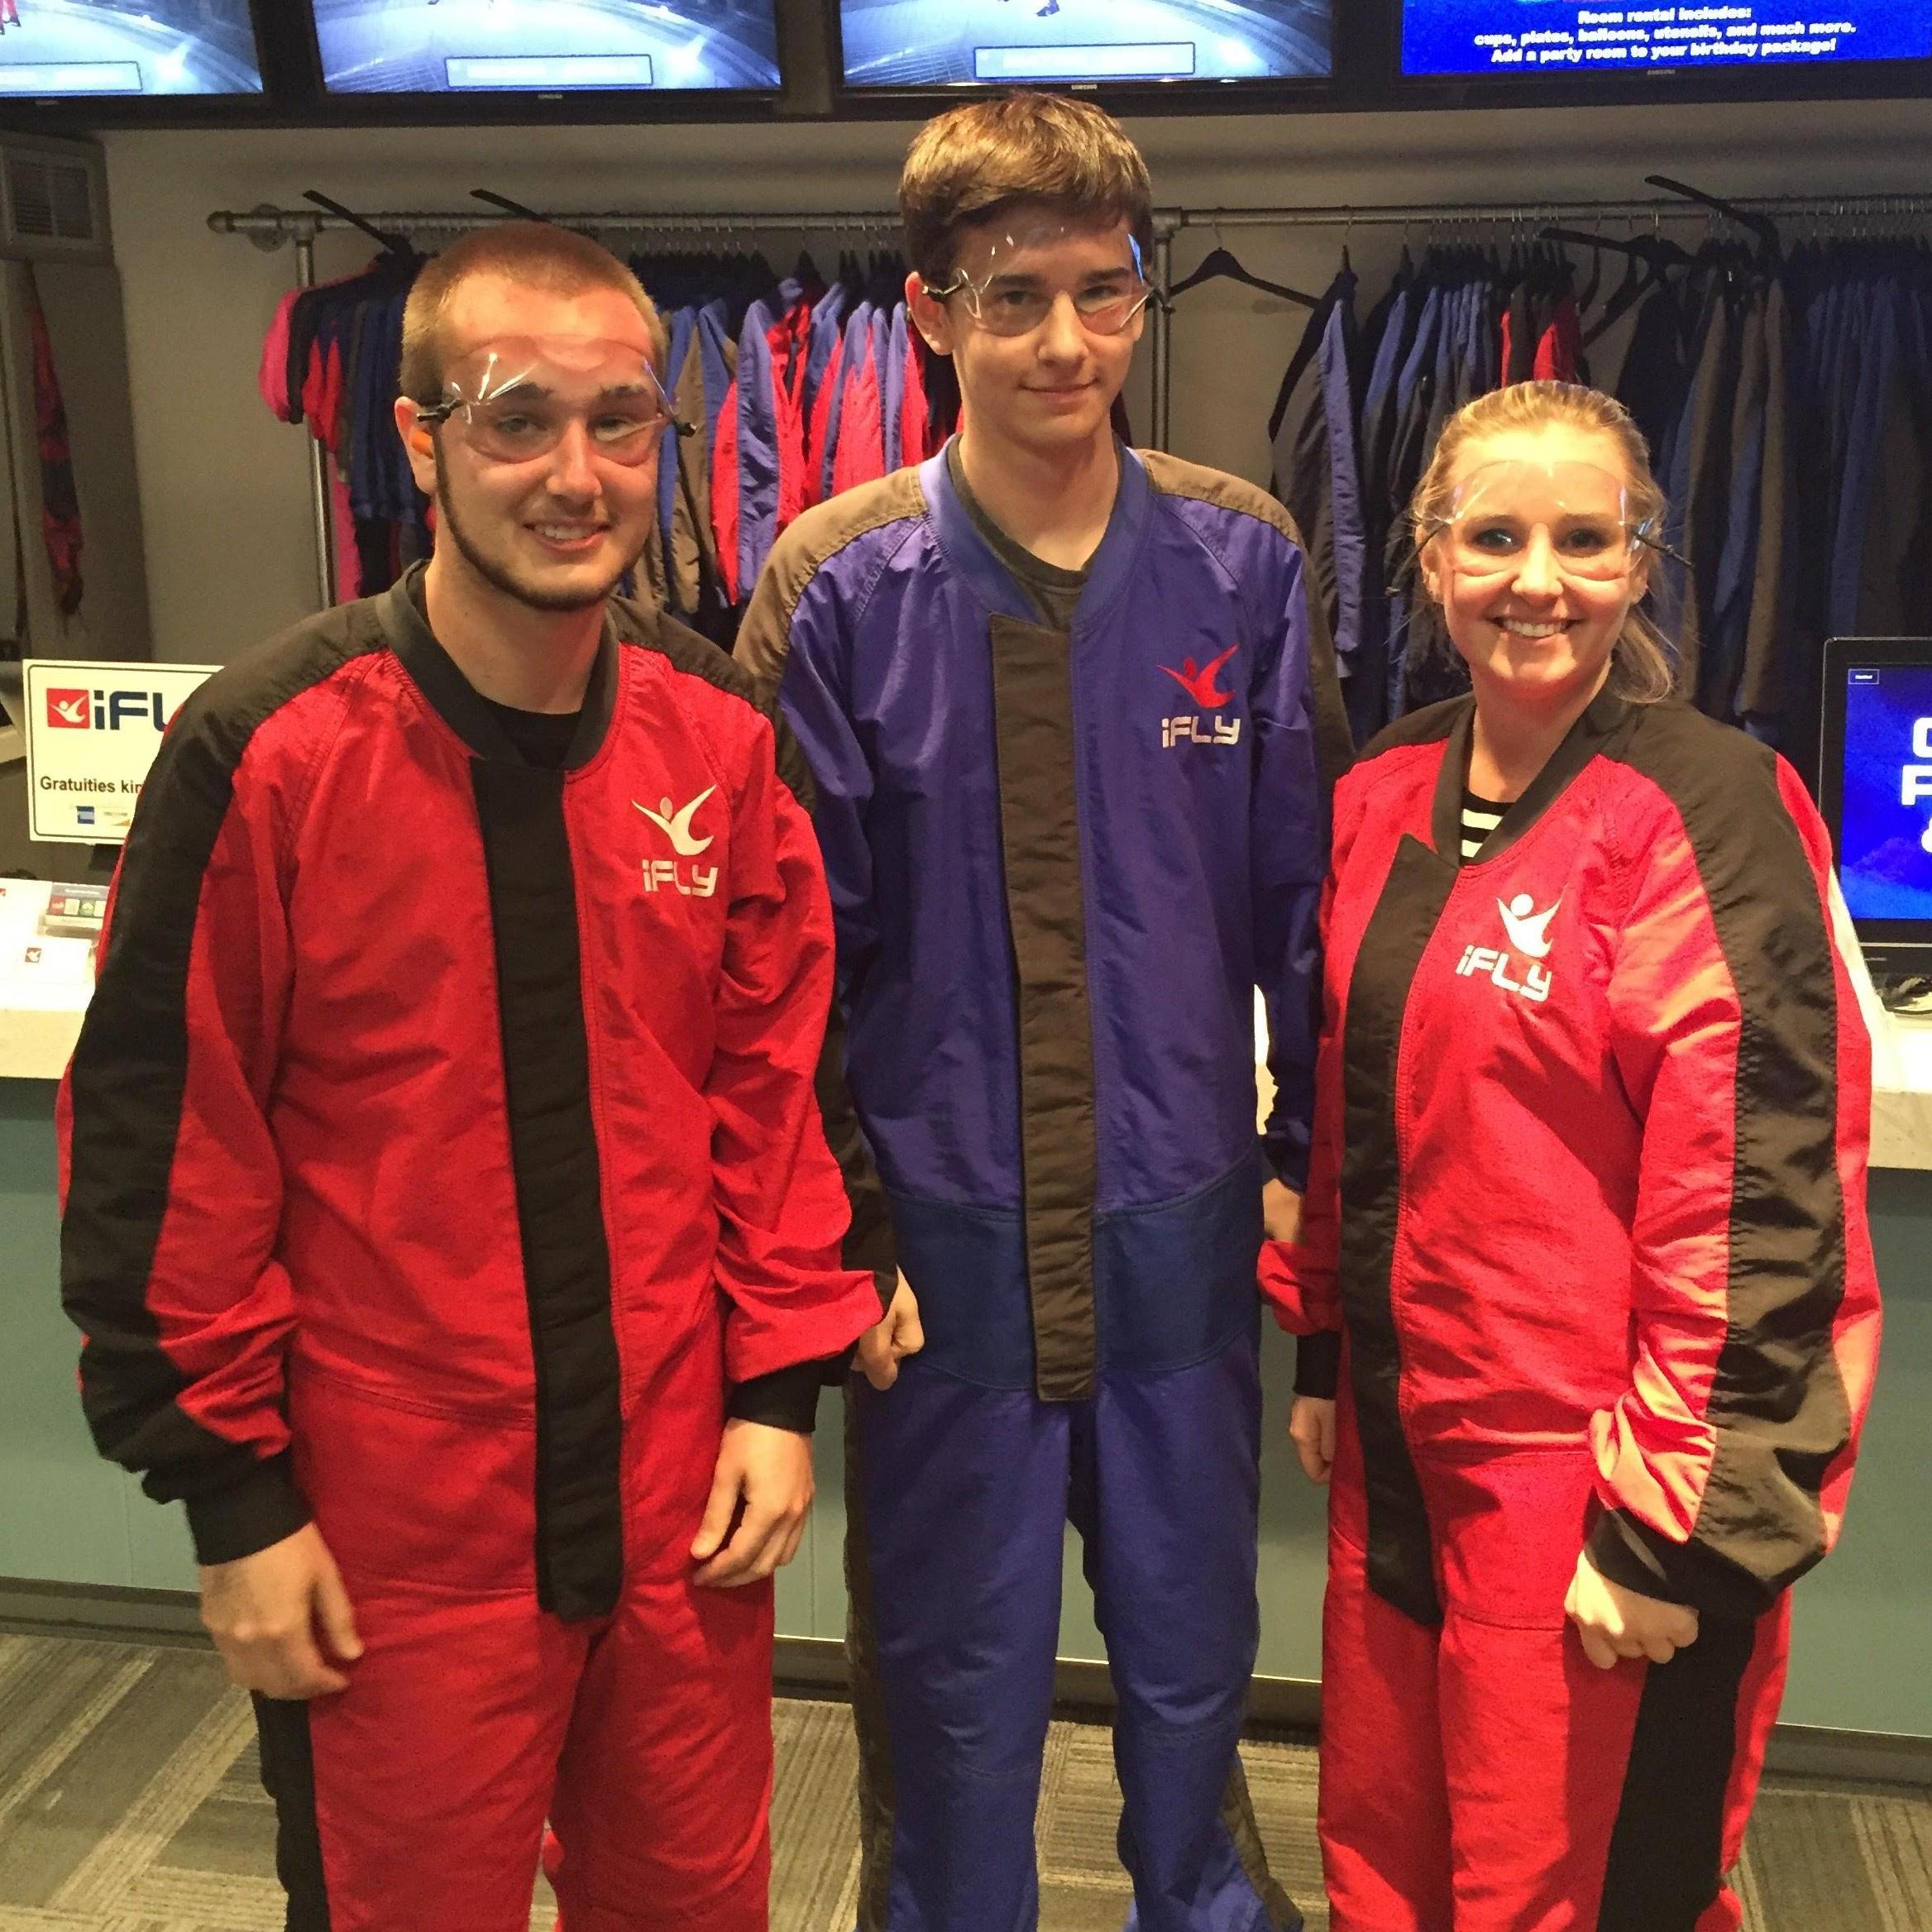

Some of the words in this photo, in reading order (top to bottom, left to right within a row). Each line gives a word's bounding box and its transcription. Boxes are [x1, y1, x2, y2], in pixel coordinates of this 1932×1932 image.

[1578, 10, 1624, 25] Room
[1627, 7, 1676, 22] rental
[1678, 5, 1752, 21] includes:
[1474, 34, 1518, 48] cups,
[1520, 30, 1575, 47] plates,
[1578, 27, 1650, 42] balloons,
[1653, 24, 1723, 40] utensils,
[1726, 22, 1757, 37] and
[1760, 21, 1805, 36] much
[1809, 22, 1857, 35] more.
[1490, 48, 1523, 63] Add
[1526, 50, 1537, 61] a
[1539, 47, 1583, 65] party
[1585, 47, 1628, 60] room
[1630, 45, 1648, 58] to
[1650, 45, 1688, 60] your
[1690, 41, 1758, 57] birthday
[1761, 37, 1837, 57] package!
[93, 689, 170, 732] iFL
[1161, 715, 1241, 748] iFLY
[40, 776, 116, 792] Gratuities
[121, 780, 146, 795] kin
[642, 858, 719, 897] iFLY
[1456, 944, 1552, 1002] iFLY
